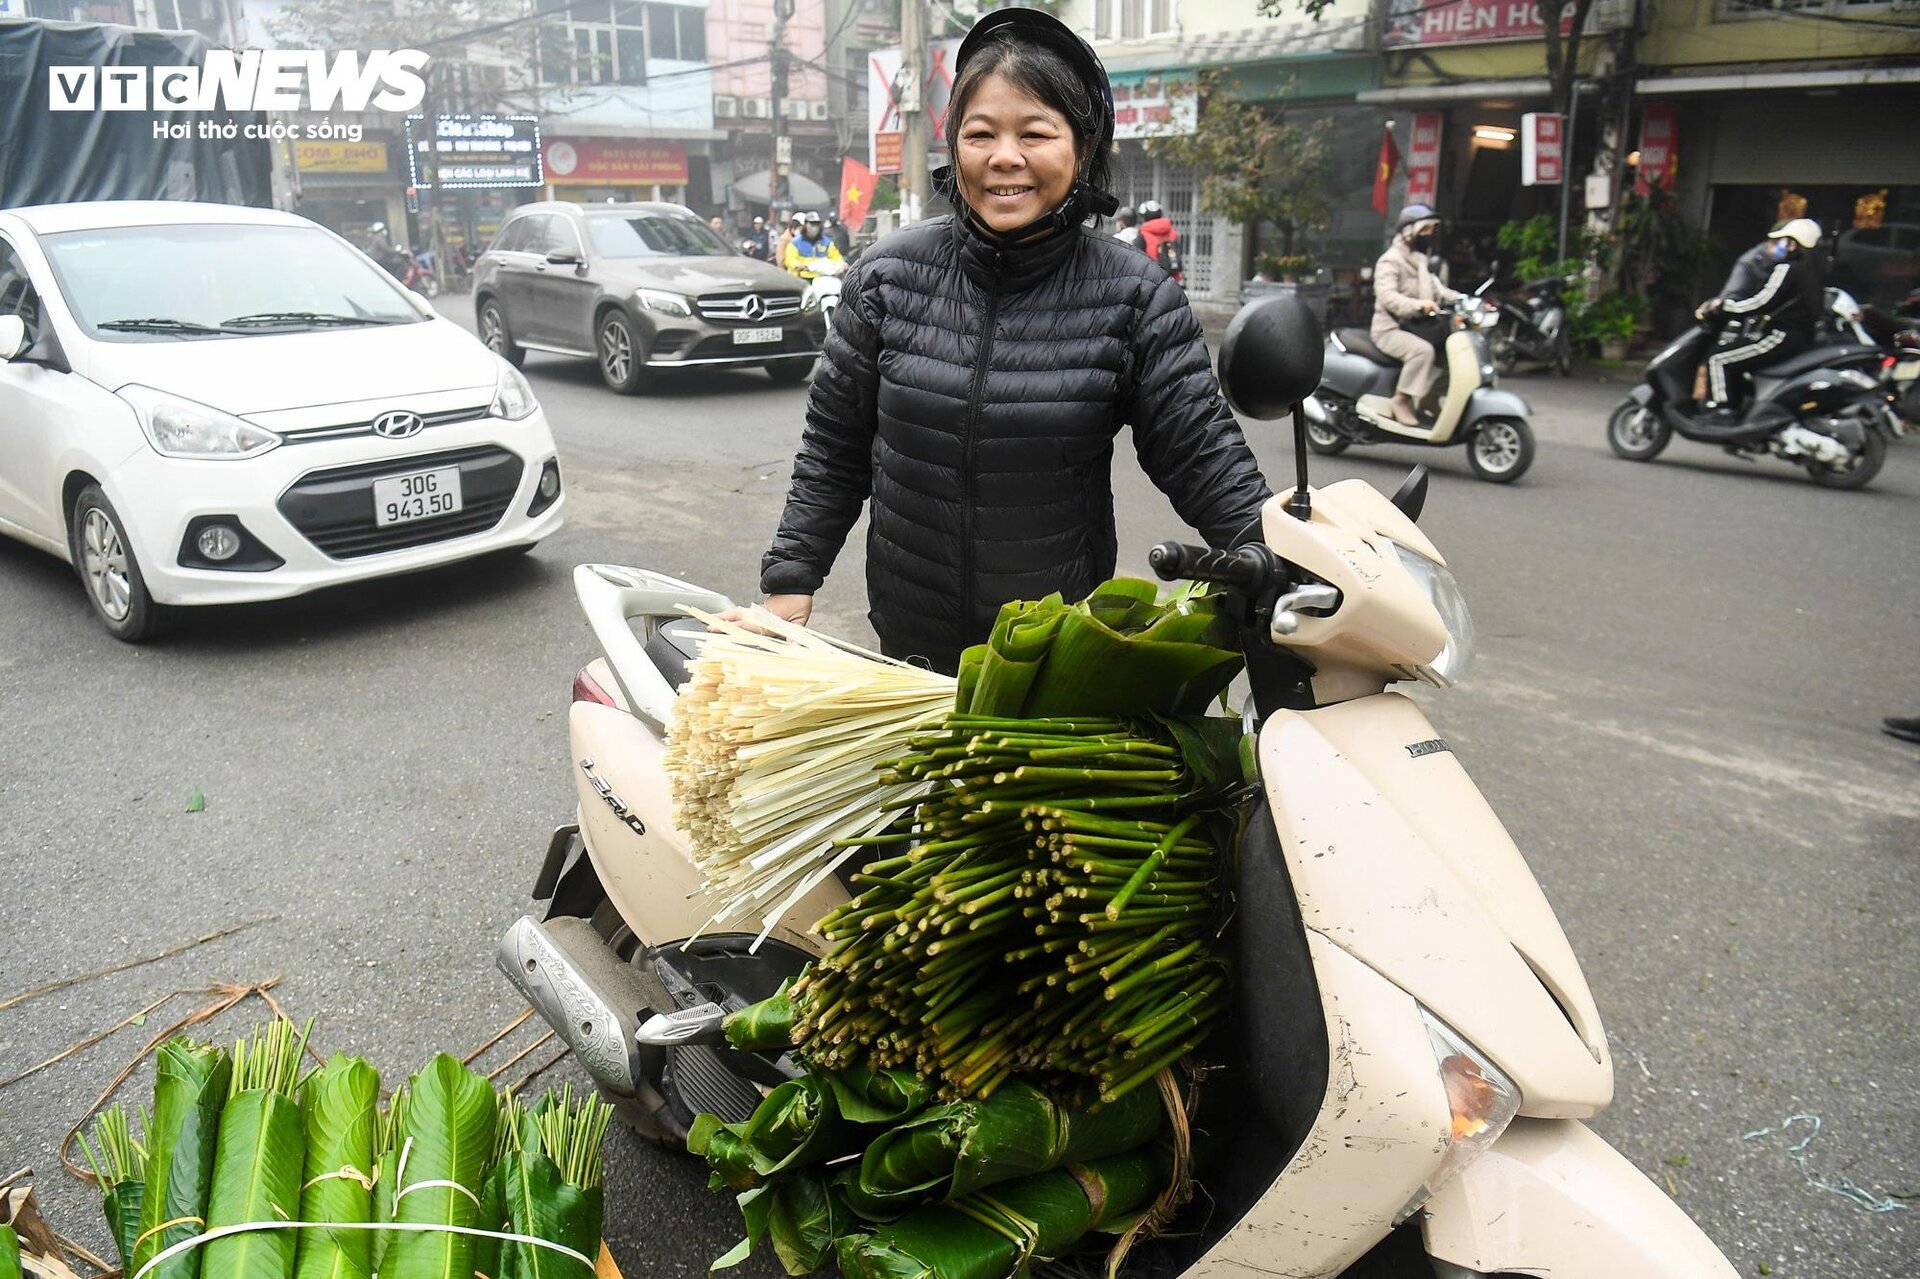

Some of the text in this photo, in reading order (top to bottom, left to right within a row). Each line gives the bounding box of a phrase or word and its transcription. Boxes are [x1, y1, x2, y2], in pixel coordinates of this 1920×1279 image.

[400, 473, 437, 497] 30G
[386, 492, 453, 522] 943.50
[579, 758, 646, 836] LEAD
